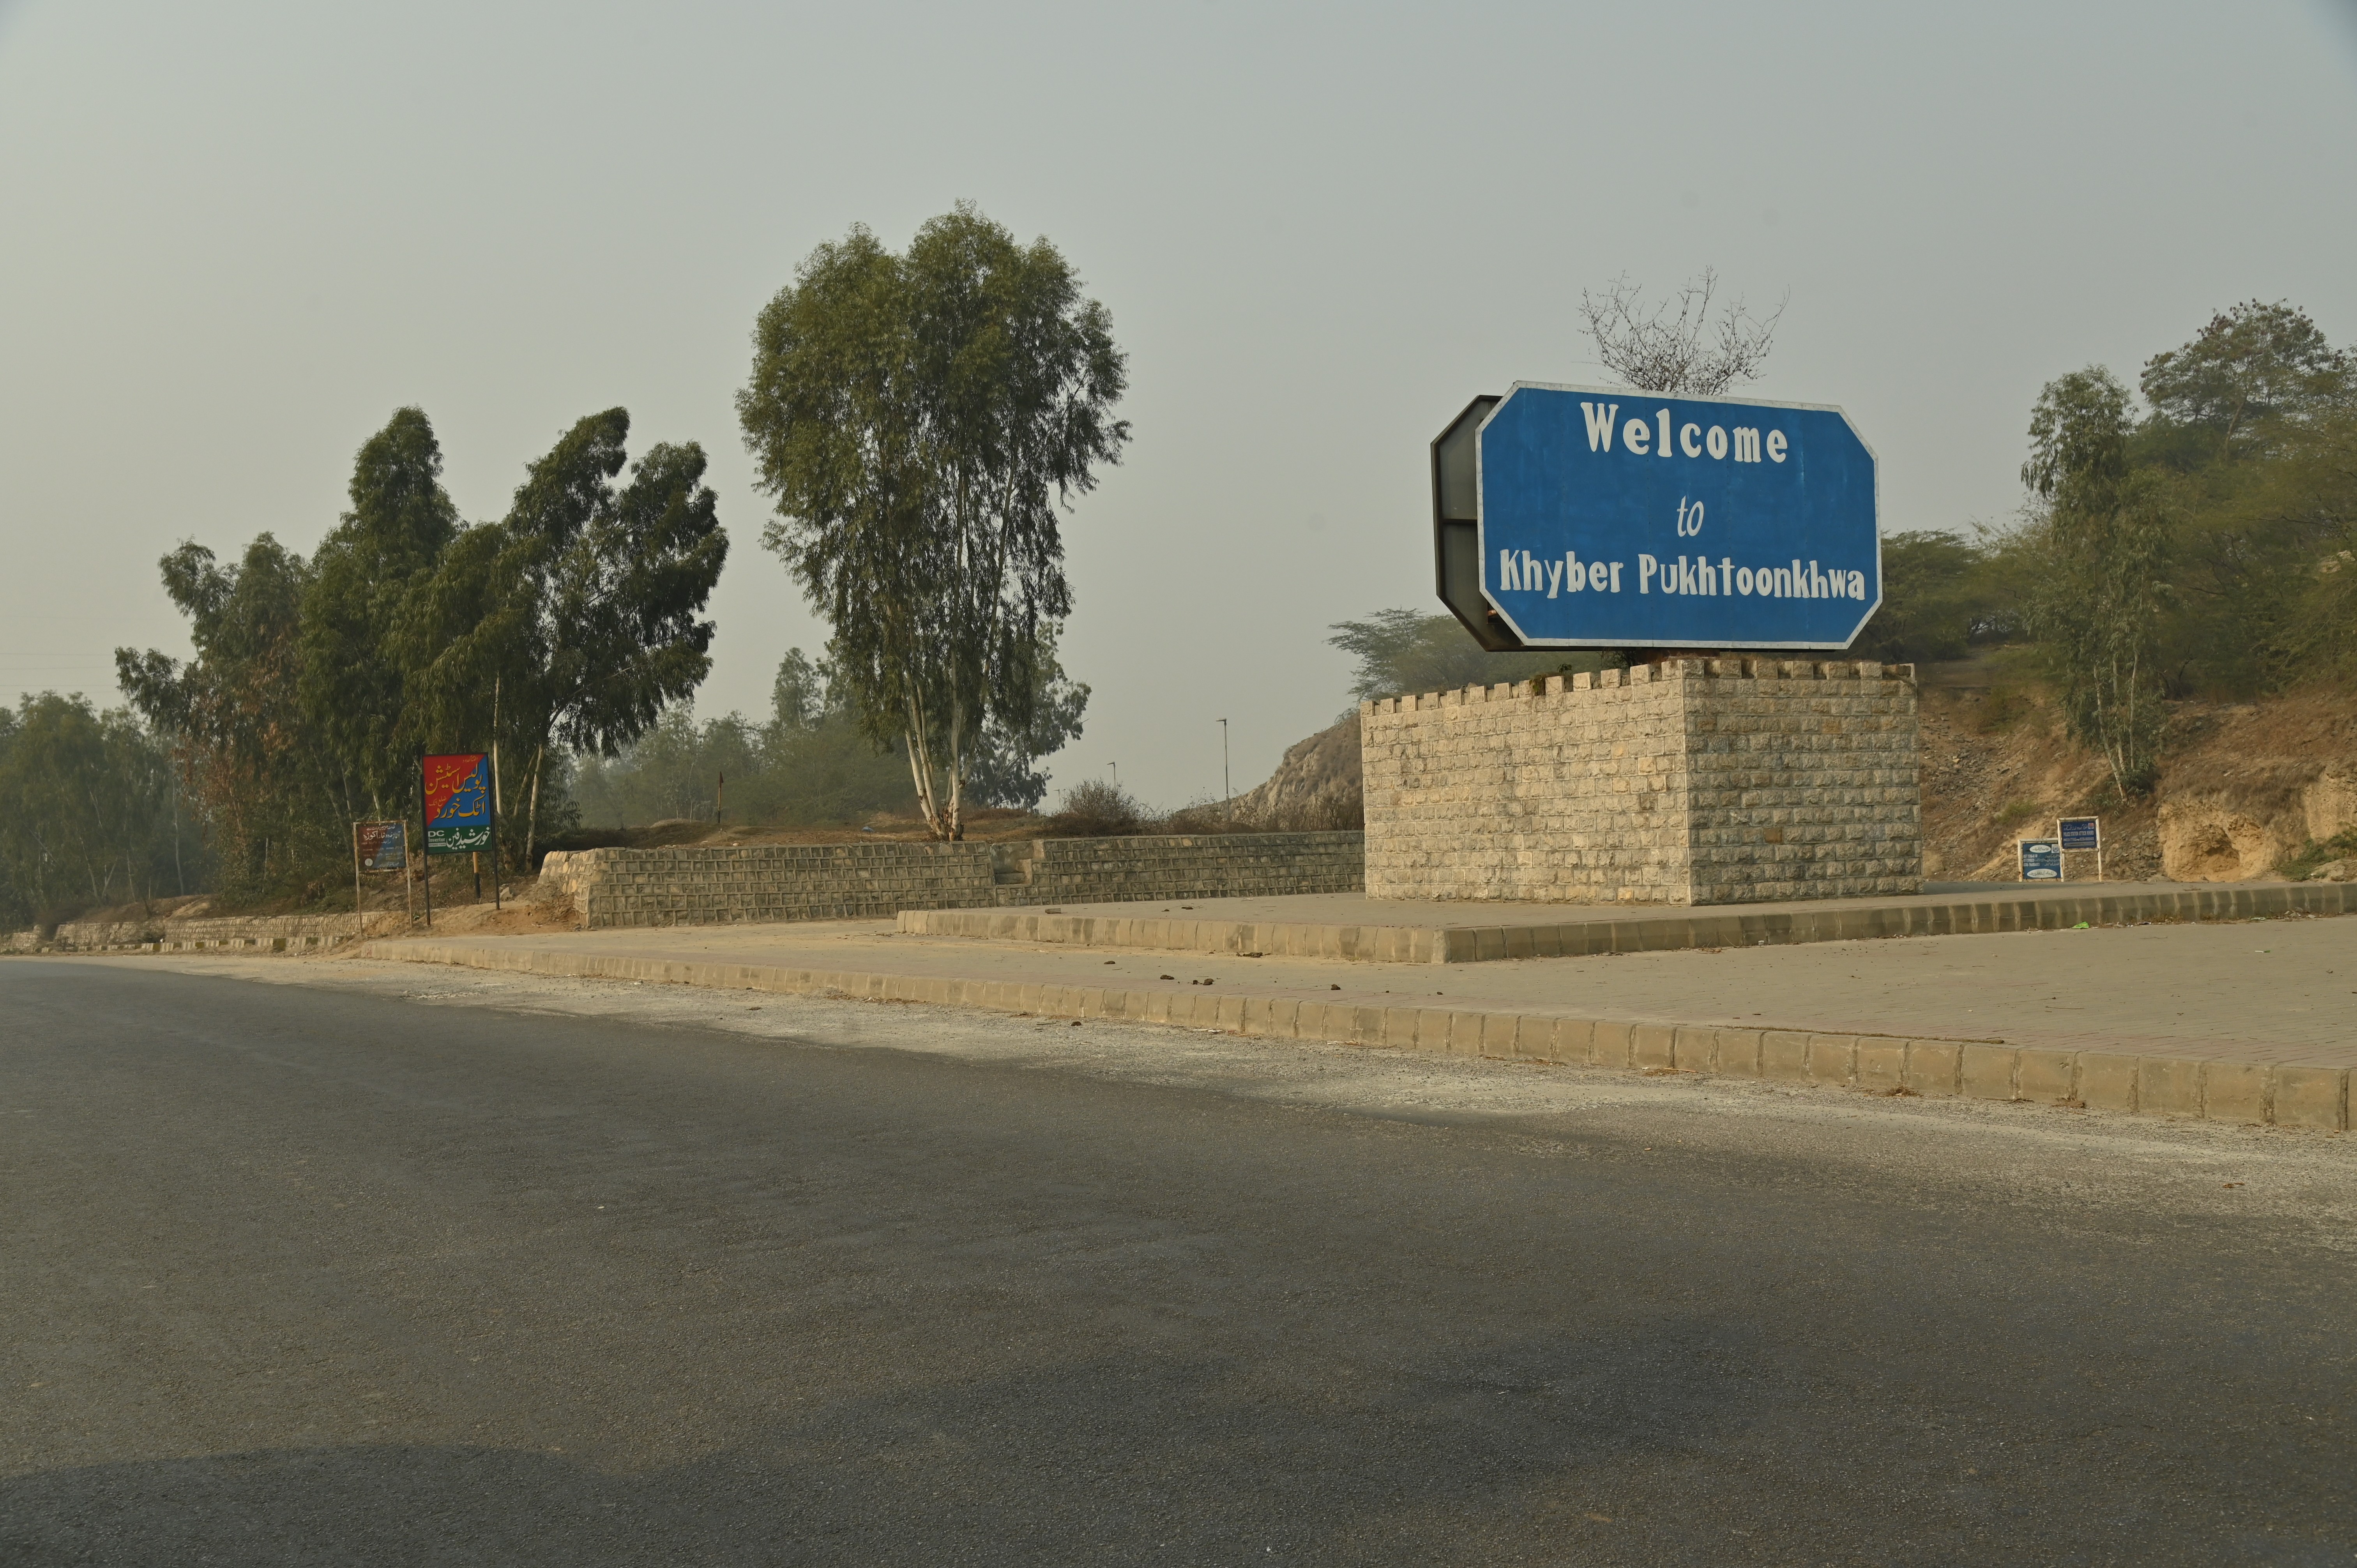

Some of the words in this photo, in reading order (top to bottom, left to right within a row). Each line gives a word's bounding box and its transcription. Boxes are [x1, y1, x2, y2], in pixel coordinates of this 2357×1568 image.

[1580, 402, 1788, 463] Welcome
[1677, 496, 1704, 537] to
[1500, 549, 1624, 599] Khyber
[1638, 554, 1865, 600] Pukhtoonkhwa
[424, 763, 461, 795] اسٹیشن
[452, 763, 487, 794] پولیس
[434, 798, 461, 819] خورد
[458, 794, 486, 817] اٹک
[446, 827, 460, 850] فین
[456, 826, 490, 849] خورشید
